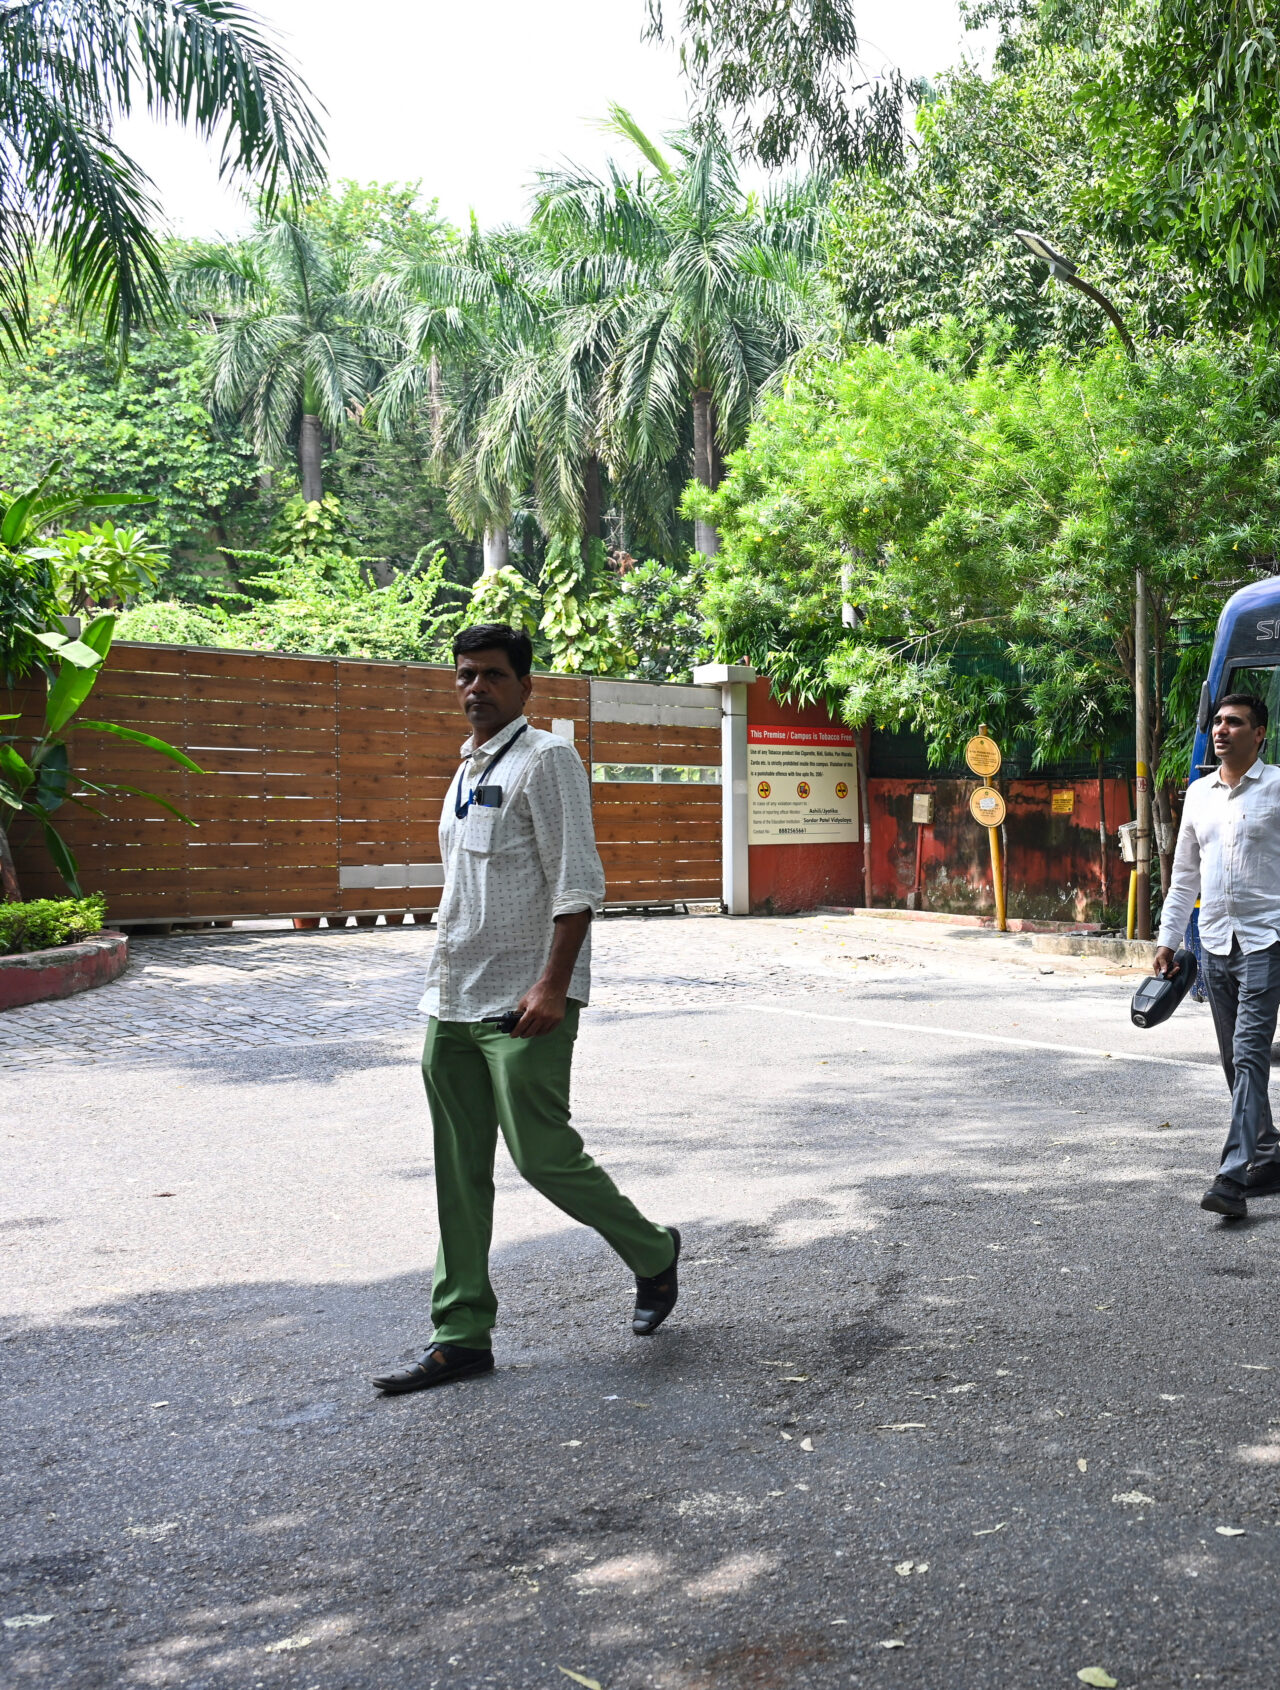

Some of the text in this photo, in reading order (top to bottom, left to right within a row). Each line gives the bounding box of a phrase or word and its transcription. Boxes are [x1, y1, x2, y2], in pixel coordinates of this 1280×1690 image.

[750, 729, 762, 738] This
[763, 730, 786, 739] Premise
[790, 731, 812, 742] Campus
[812, 731, 818, 740] is
[818, 732, 840, 741] Tobacco
[840, 733, 853, 741] Free
